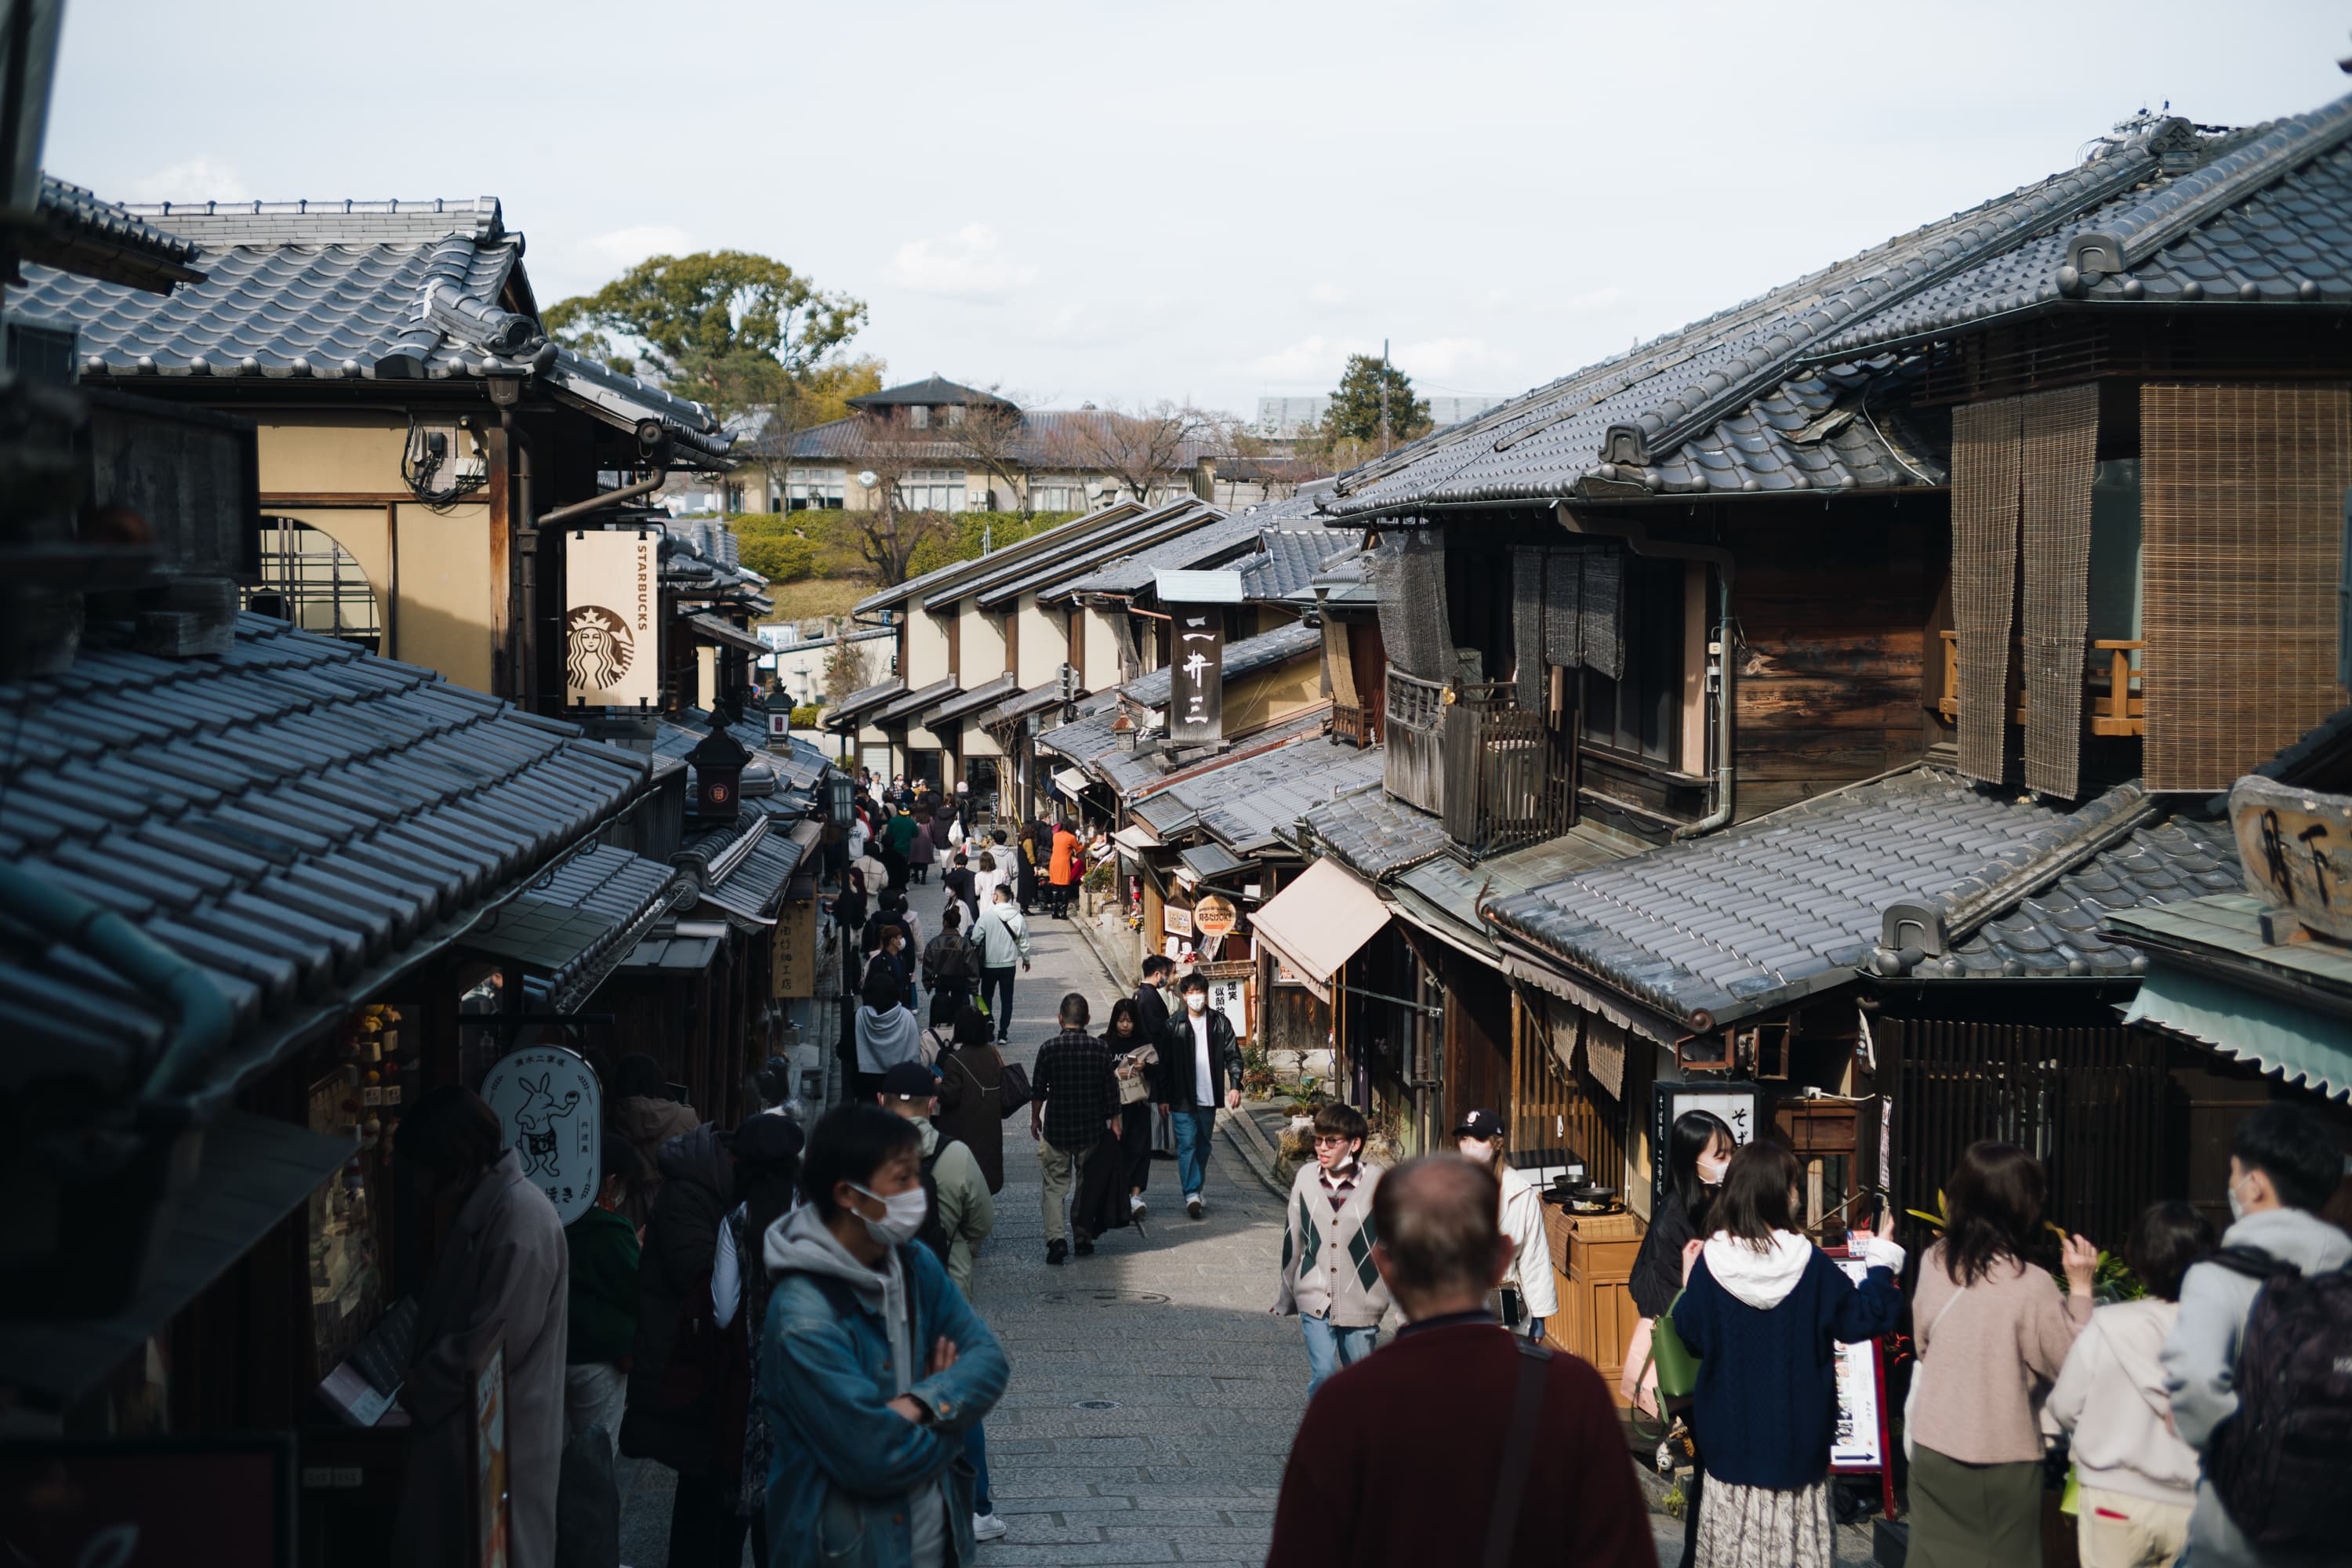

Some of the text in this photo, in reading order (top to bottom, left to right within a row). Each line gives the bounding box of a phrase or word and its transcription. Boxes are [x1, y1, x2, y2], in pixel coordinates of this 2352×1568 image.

[637, 545, 648, 630] STARBUCKS
[1227, 981, 1237, 1001] 爆笑
[1732, 1108, 1748, 1148] そば
